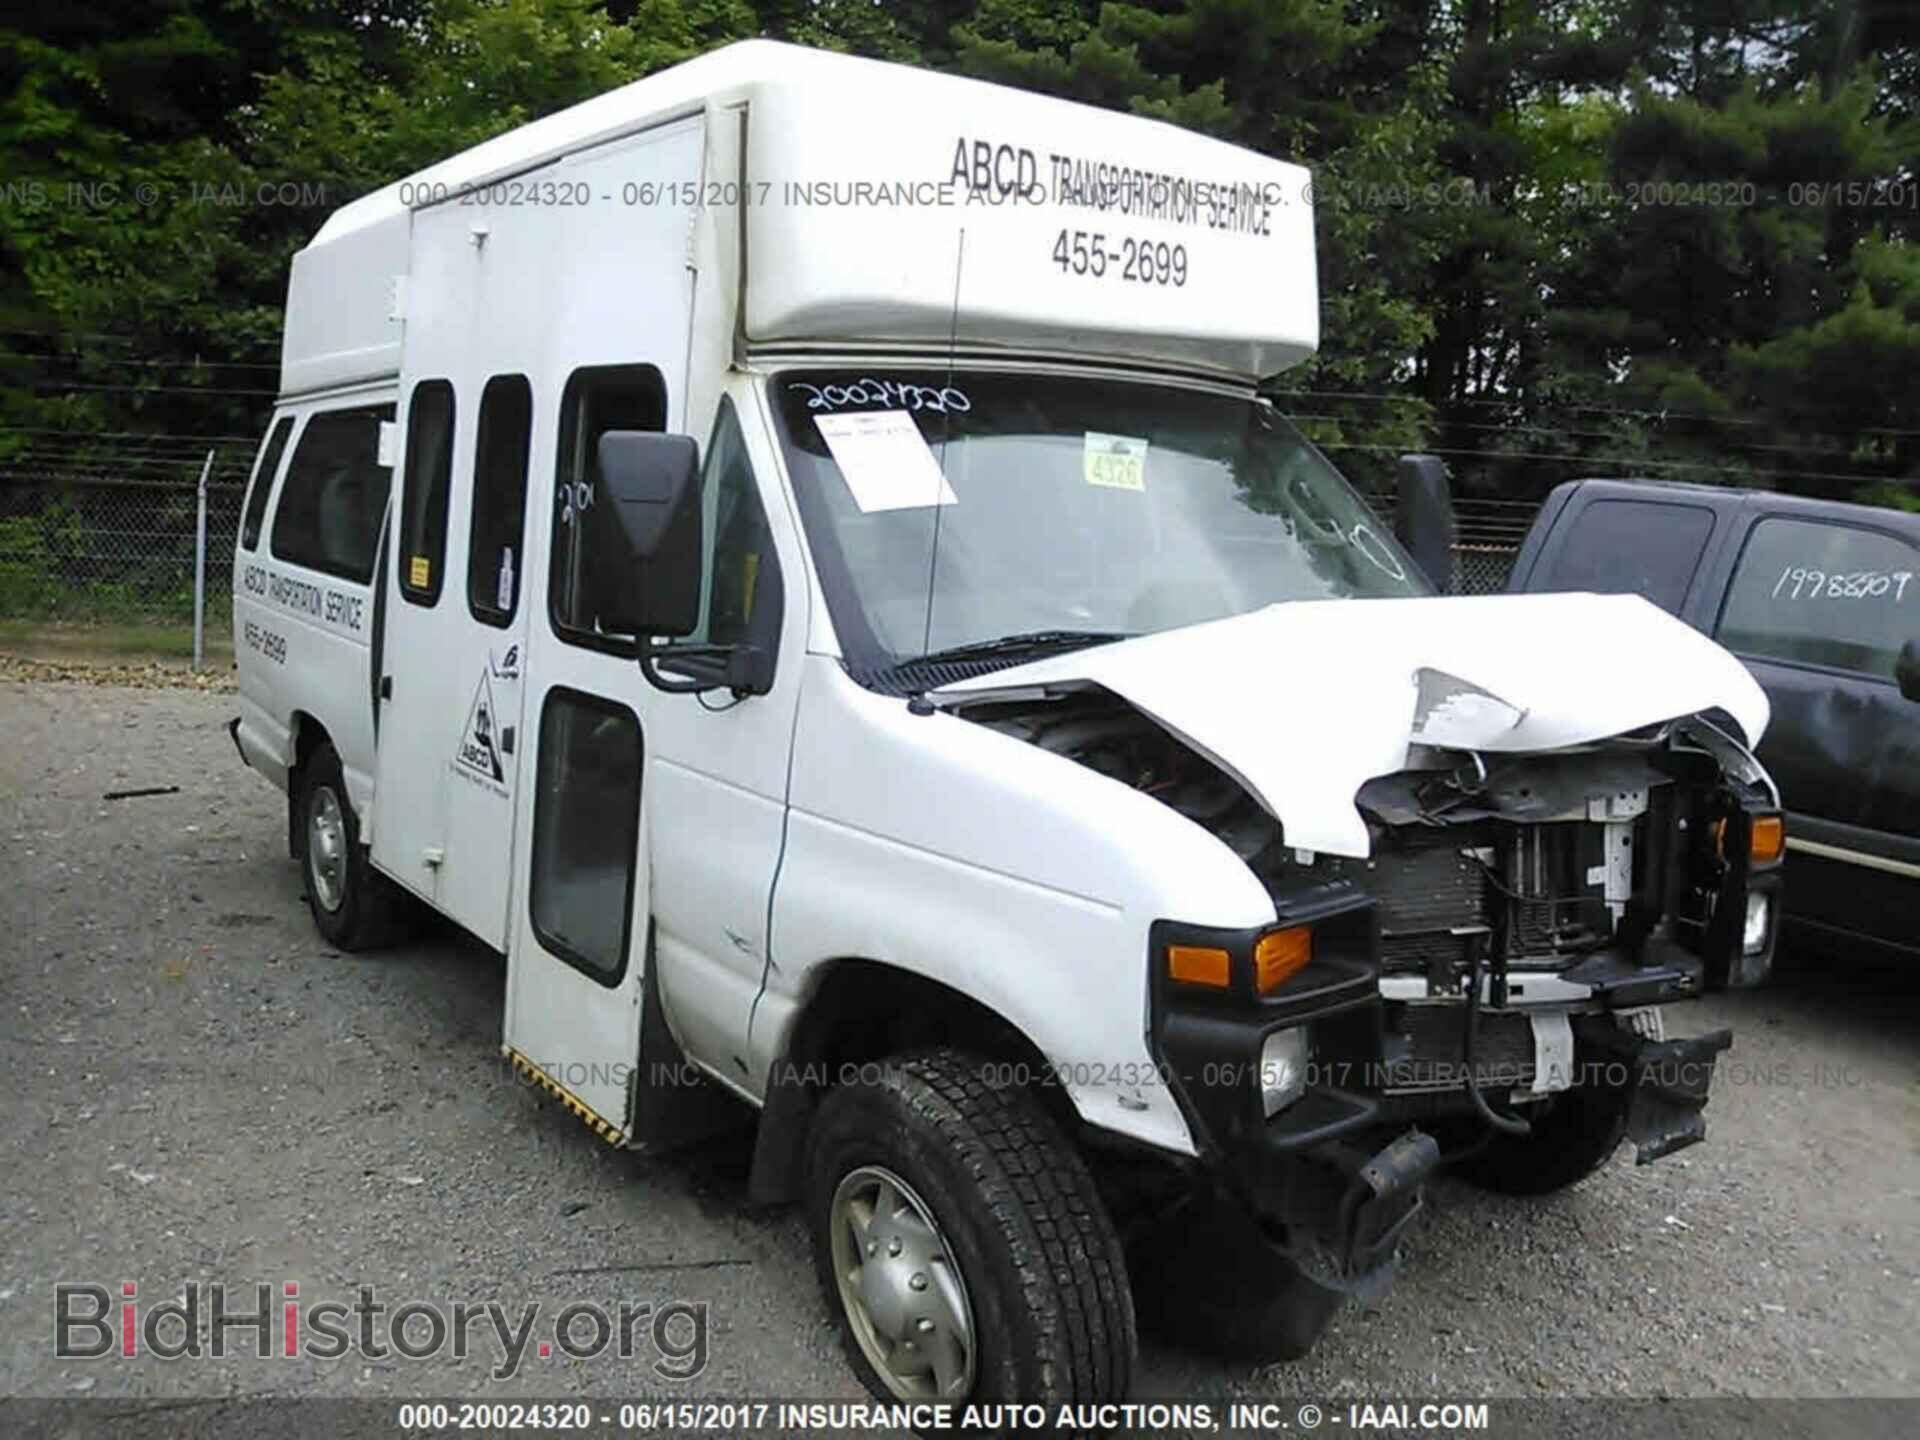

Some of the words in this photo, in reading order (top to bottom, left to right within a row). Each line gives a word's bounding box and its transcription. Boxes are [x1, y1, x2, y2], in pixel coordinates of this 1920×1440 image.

[951, 137, 1036, 197] ABCD
[1050, 154, 1198, 225] TRANSPORTATION
[1207, 182, 1271, 236] SERVICE
[1053, 229, 1188, 287] 455-2699
[788, 378, 970, 413] 20024320
